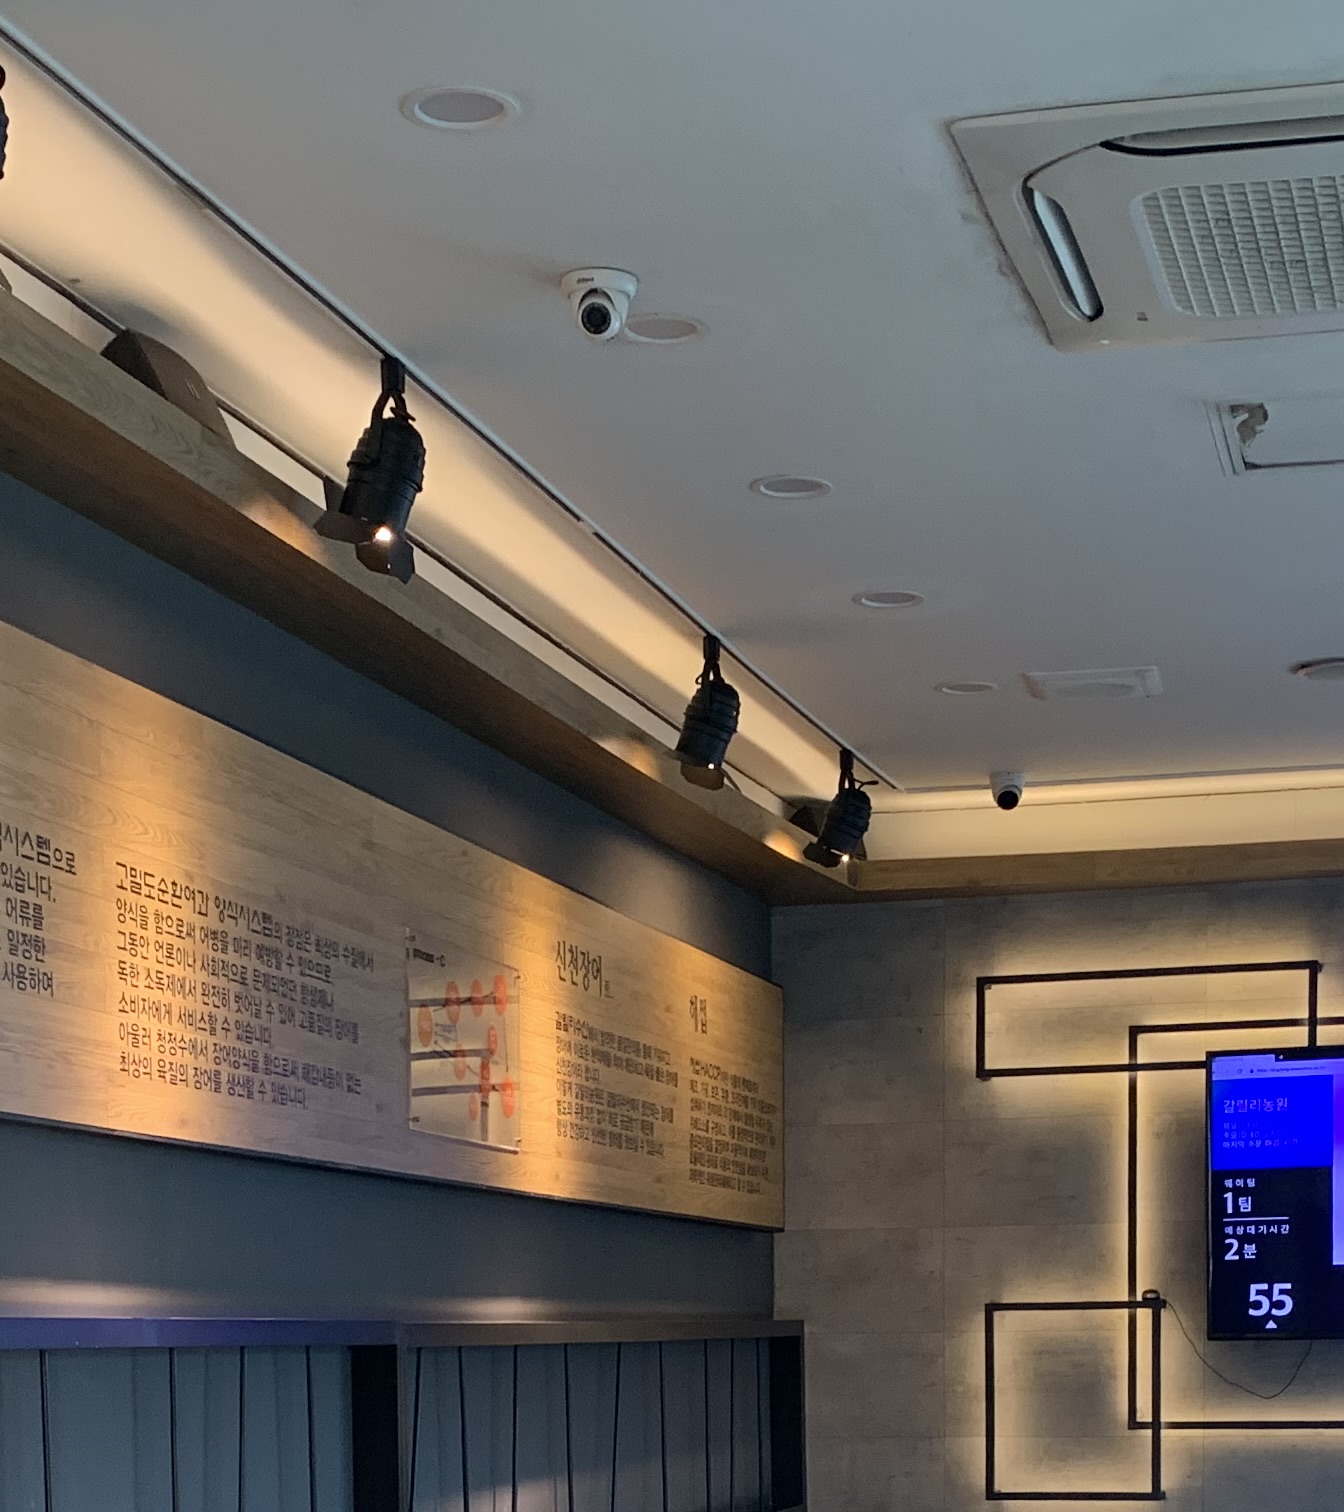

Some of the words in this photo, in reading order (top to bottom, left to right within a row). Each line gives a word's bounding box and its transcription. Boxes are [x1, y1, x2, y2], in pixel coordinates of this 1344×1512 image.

[0, 861, 56, 903] 있습니다.
[5, 897, 44, 930] 어류를
[6, 928, 45, 963] 일정한
[115, 897, 149, 930] 양식을
[153, 908, 195, 944] 함으로써
[285, 951, 294, 973] 수
[116, 929, 149, 960] 그동안
[153, 939, 196, 974] 언론이나
[199, 954, 248, 986] 사회적으로
[1, 961, 53, 997] 사용하여
[117, 959, 139, 988] 독한
[143, 967, 196, 1002] 소독제에서
[118, 991, 172, 1025] 소비자에게
[176, 1005, 217, 1036] 서비스할
[220, 1016, 231, 1038] 수
[118, 1021, 151, 1051] 아울러
[156, 1028, 207, 1061] 청정수에서
[119, 1050, 152, 1081] 최상의
[156, 1058, 188, 1087] 육질의
[1248, 1283, 1293, 1317] 55
